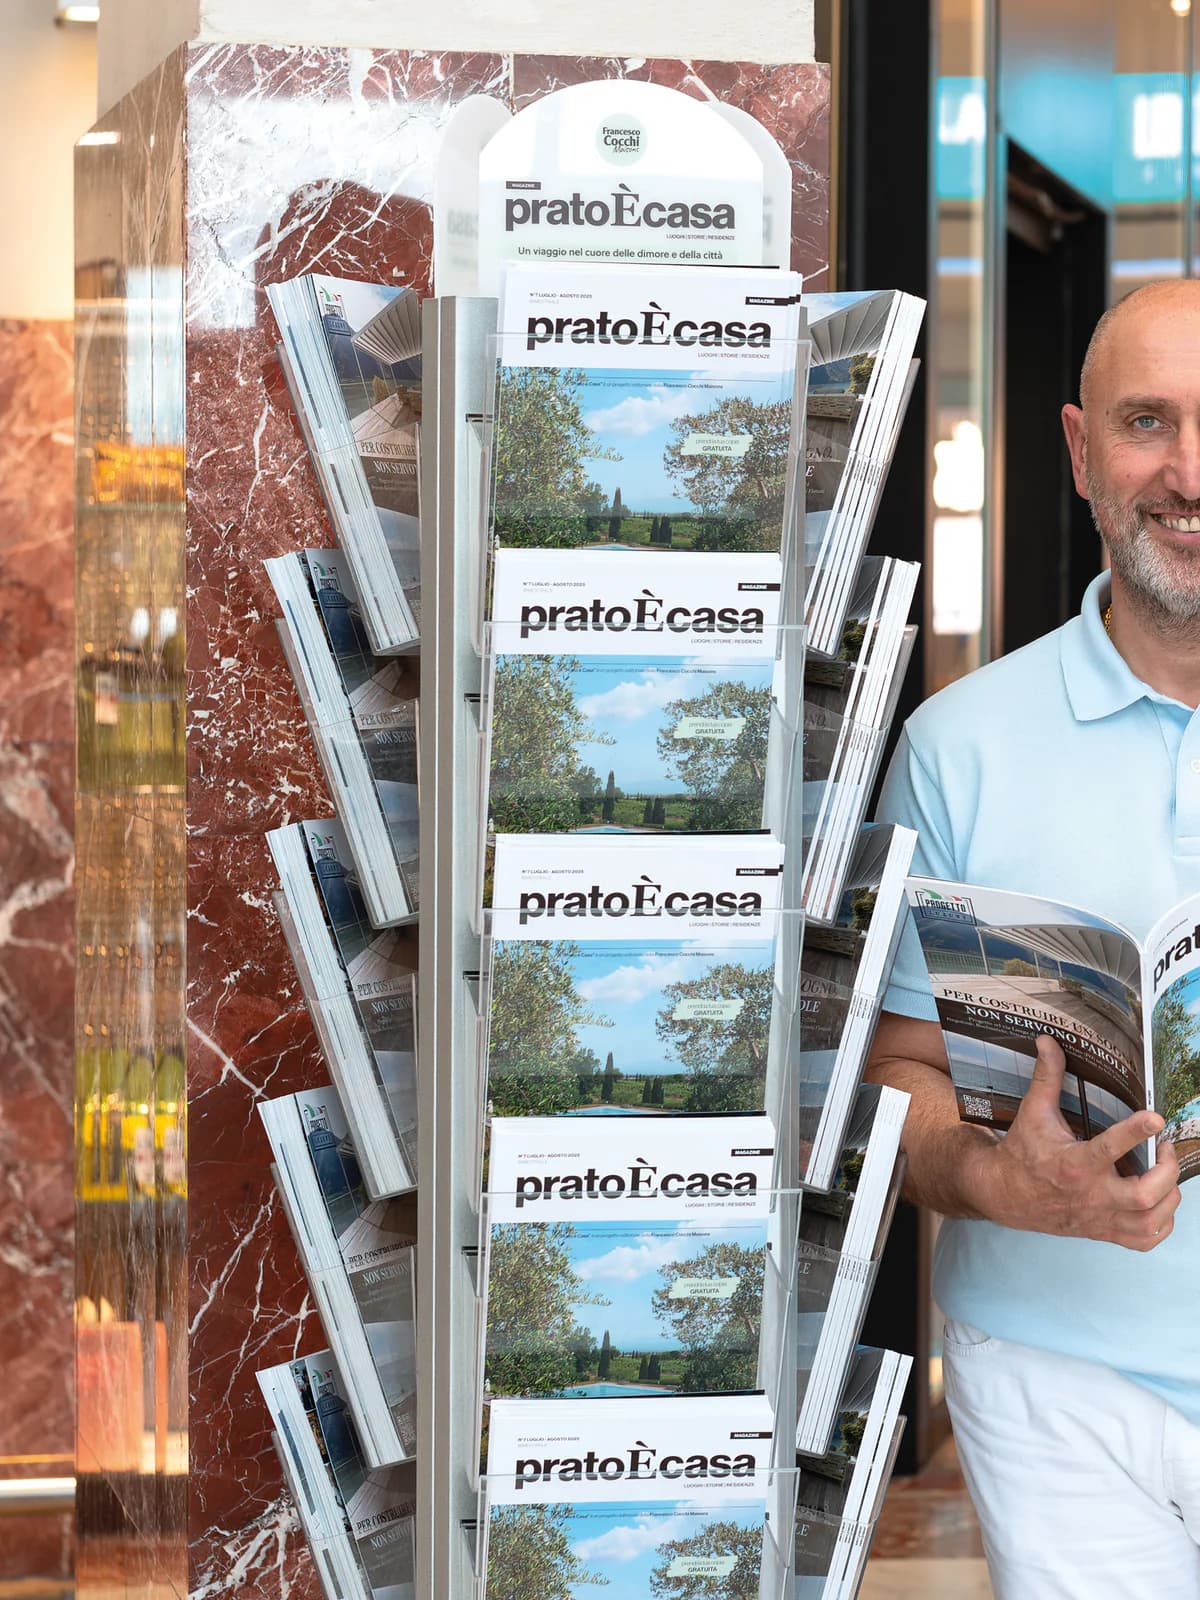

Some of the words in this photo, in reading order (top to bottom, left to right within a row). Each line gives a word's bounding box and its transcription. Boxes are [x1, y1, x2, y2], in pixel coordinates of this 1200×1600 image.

[602, 126, 641, 136] Francesco
[603, 134, 640, 147] Cocchi
[506, 183, 735, 232] pratoÈcasa
[518, 246, 531, 257] Un
[533, 247, 567, 259] viaggio
[569, 247, 582, 257] nel
[585, 249, 610, 257] cuore
[613, 248, 635, 258] delle
[637, 249, 669, 259] dimore
[680, 249, 701, 260] della
[703, 249, 723, 260] città
[527, 301, 772, 350] pratoÈcasa
[361, 441, 376, 454] PER
[374, 460, 391, 473] NON
[520, 589, 764, 638] pratoÈcasa
[519, 875, 762, 925] pratoÈcasa
[925, 899, 967, 913] PROGETTO
[357, 982, 373, 997] PER
[371, 999, 390, 1014] NON
[943, 988, 974, 1003] PER
[979, 995, 1069, 1029] COSTRUIRE
[1073, 1022, 1093, 1038] UN
[964, 1005, 1001, 1021] NON
[1004, 1014, 1077, 1043] SERVONO
[1080, 1040, 1129, 1079] PAROLE
[516, 1157, 757, 1208] pratoÈcasa
[362, 1270, 381, 1286] NON
[515, 1440, 756, 1490] pratoÈcasa
[370, 1534, 388, 1551] NON
